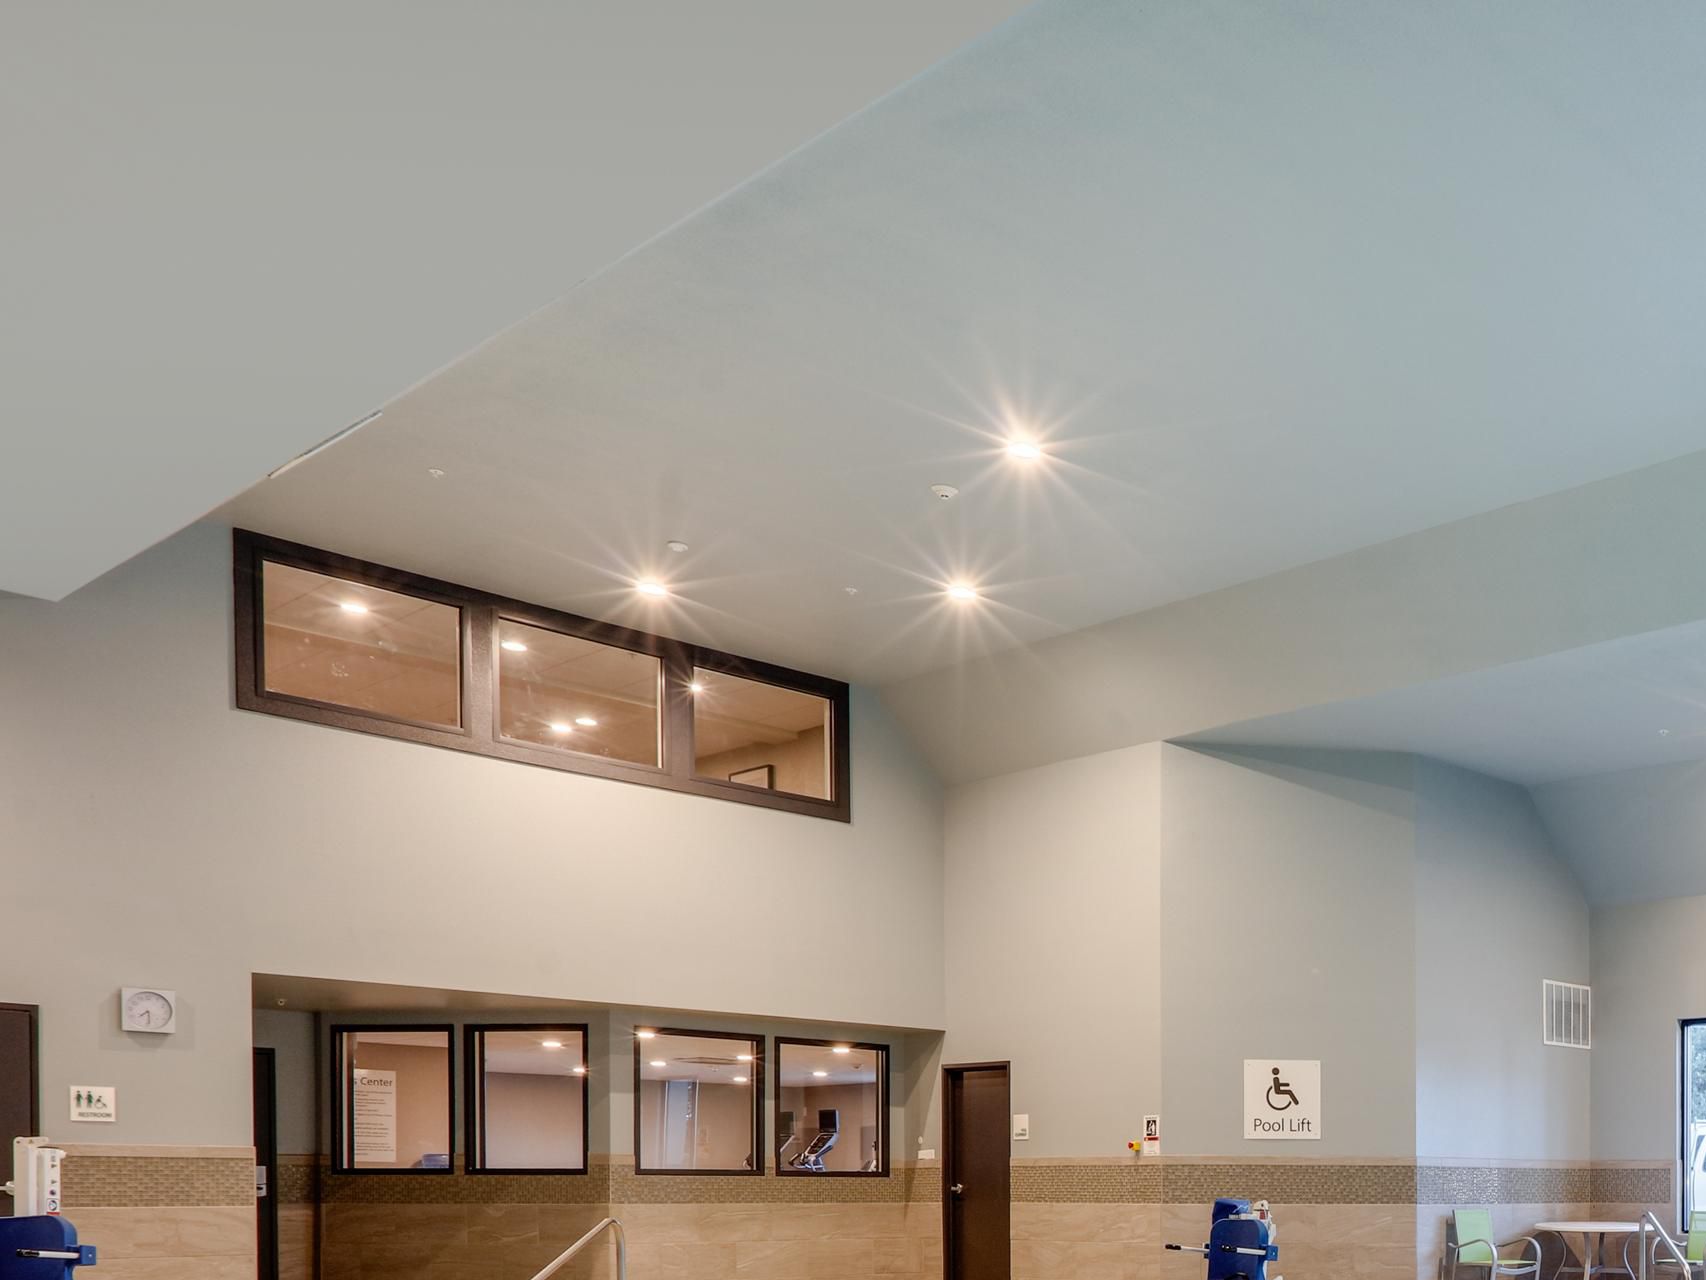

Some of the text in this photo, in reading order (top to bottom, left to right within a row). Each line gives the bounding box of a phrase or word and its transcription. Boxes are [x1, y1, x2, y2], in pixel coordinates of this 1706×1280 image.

[360, 1077, 393, 1087] Center
[1253, 1117, 1312, 1132] Pool Lift
